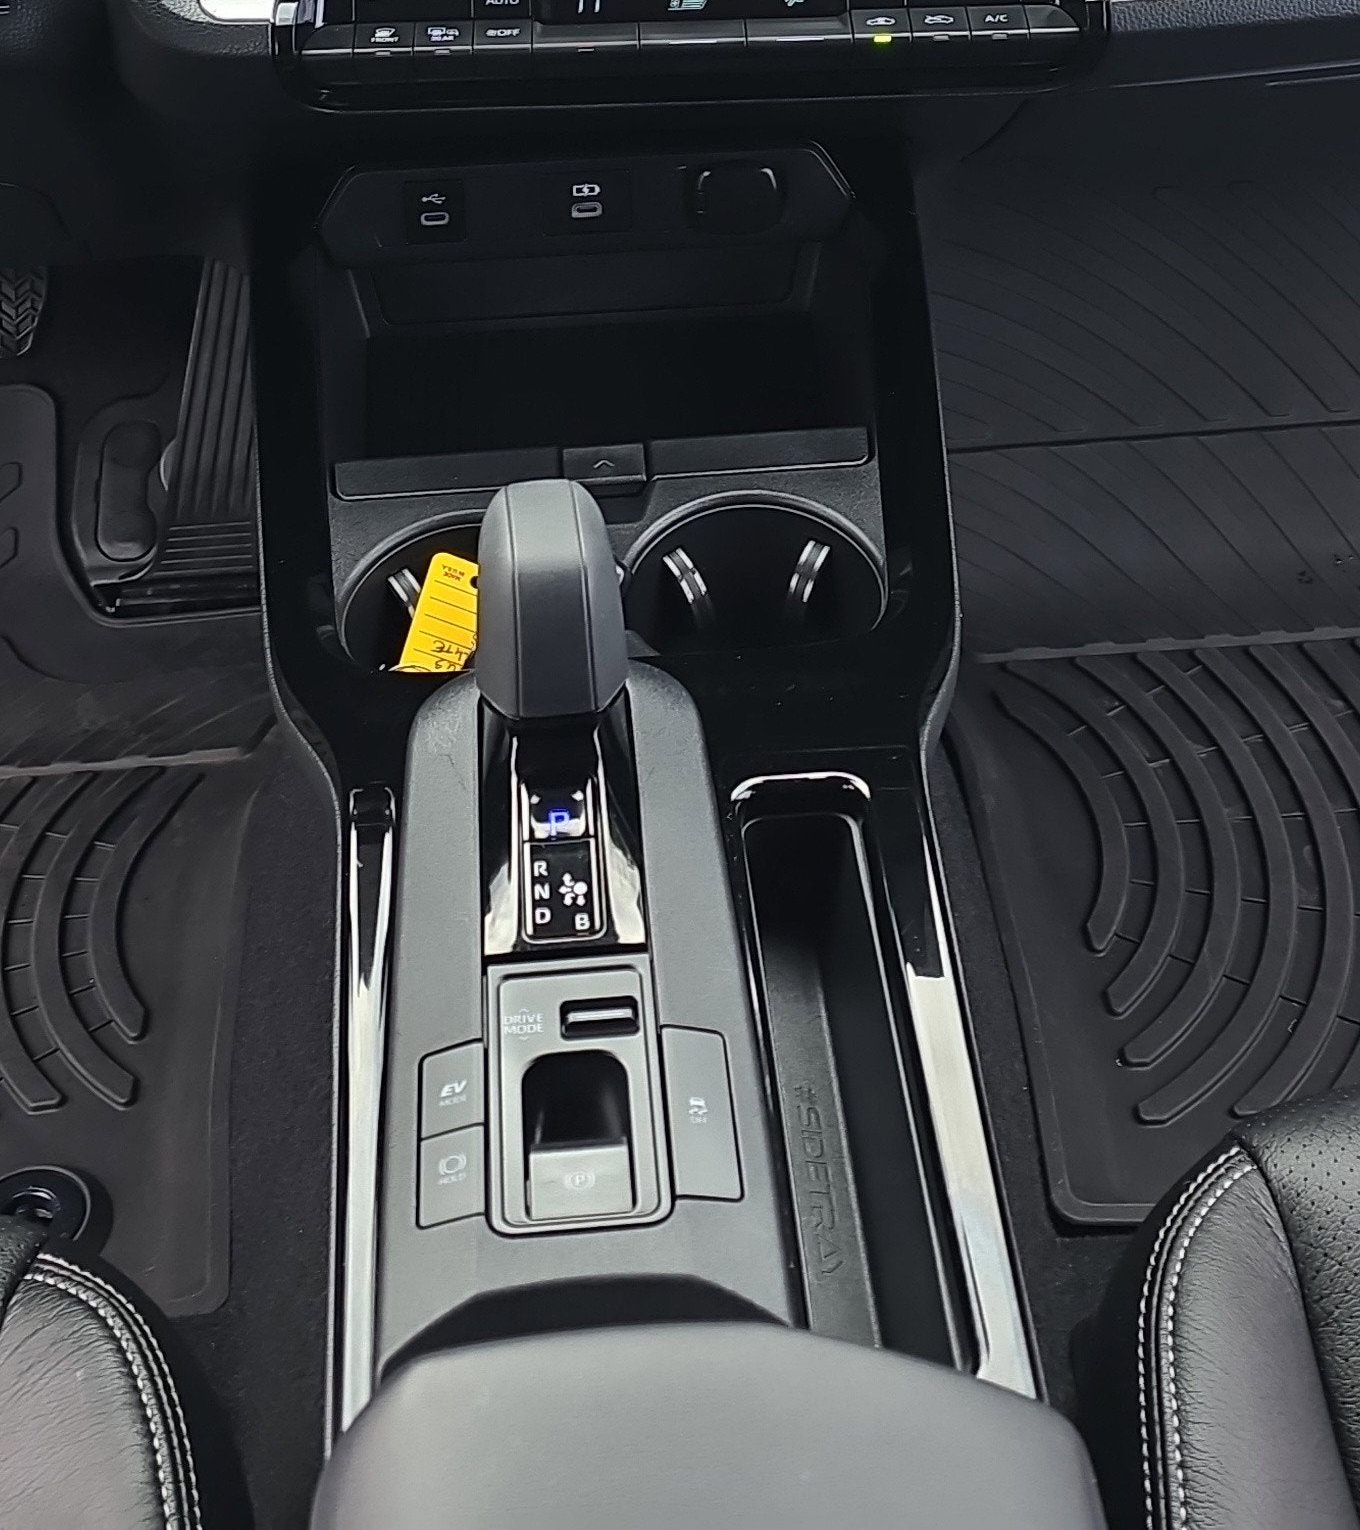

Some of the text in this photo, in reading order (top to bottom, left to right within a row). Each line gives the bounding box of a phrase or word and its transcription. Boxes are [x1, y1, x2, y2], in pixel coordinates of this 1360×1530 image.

[984, 13, 1009, 23] A/C
[370, 35, 400, 43] FRONT
[496, 28, 521, 37] OFF
[549, 810, 570, 837] P
[533, 860, 548, 877] R
[534, 882, 550, 900] N
[534, 907, 551, 924] D
[574, 912, 590, 930] B
[504, 1013, 544, 1025] DRIVE
[504, 1023, 544, 1035] MODE
[439, 1080, 468, 1098] EV
